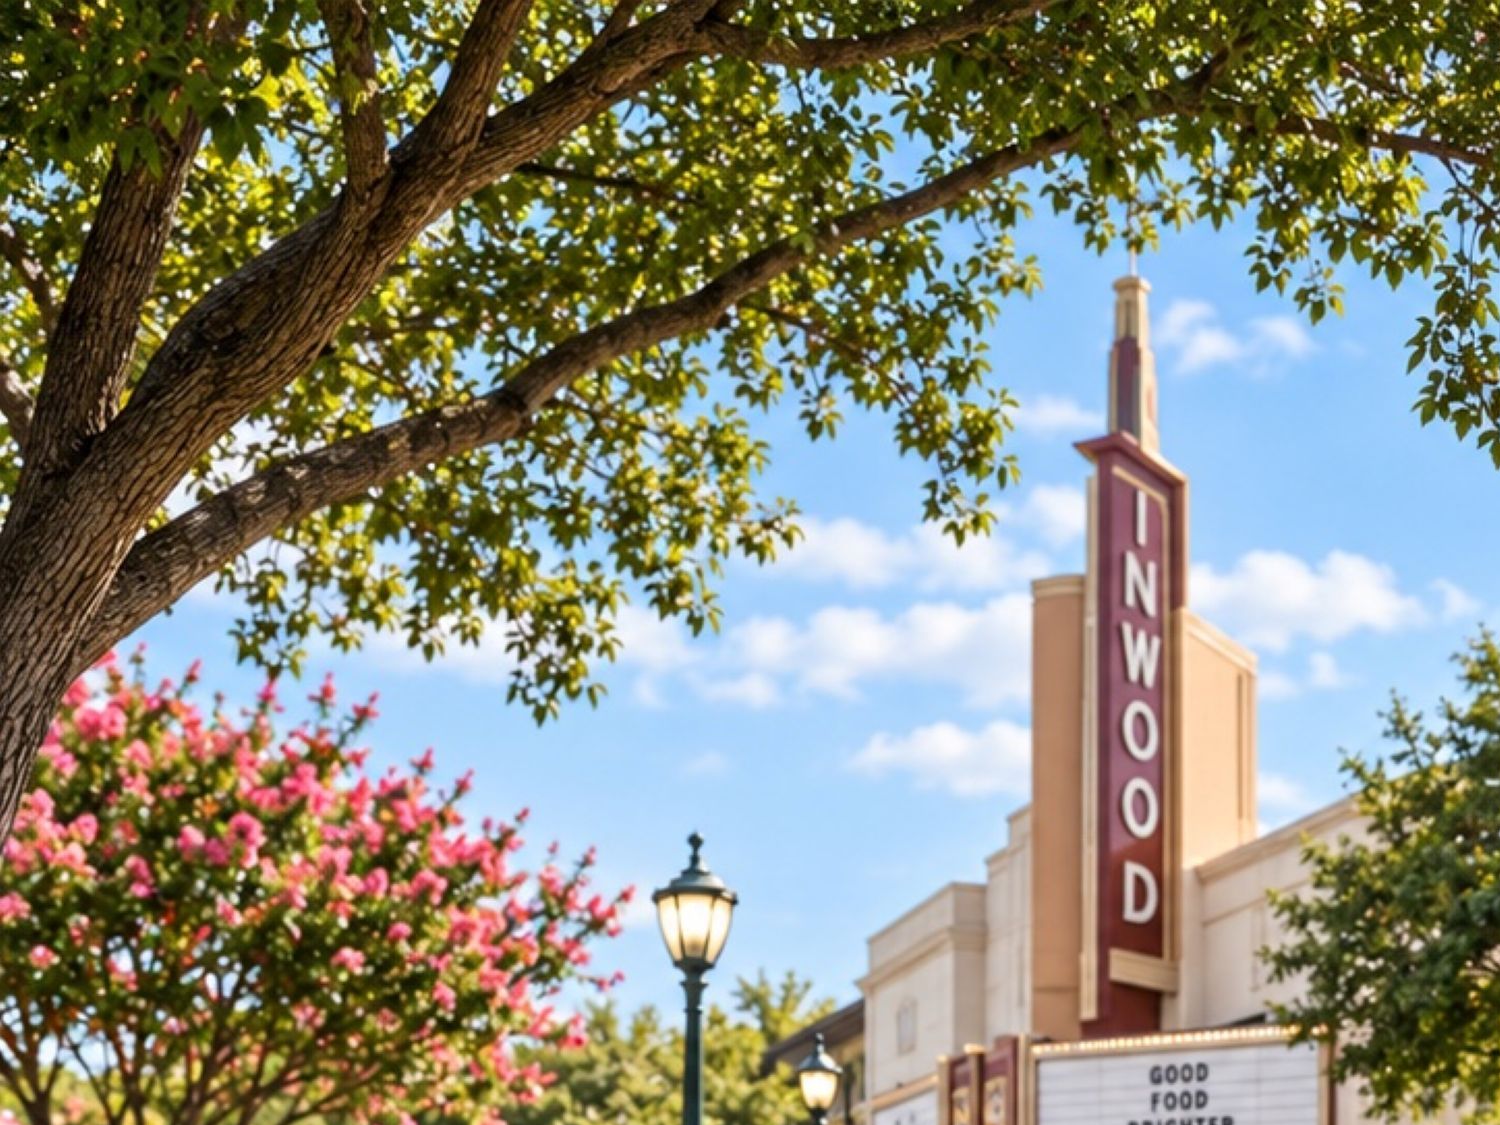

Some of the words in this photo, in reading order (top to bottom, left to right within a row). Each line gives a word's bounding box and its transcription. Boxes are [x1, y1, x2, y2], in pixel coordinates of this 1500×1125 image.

[1121, 489, 1160, 924] INWOOD
[1149, 1062, 1209, 1085] GOOD
[1150, 1090, 1209, 1112] FOOD
